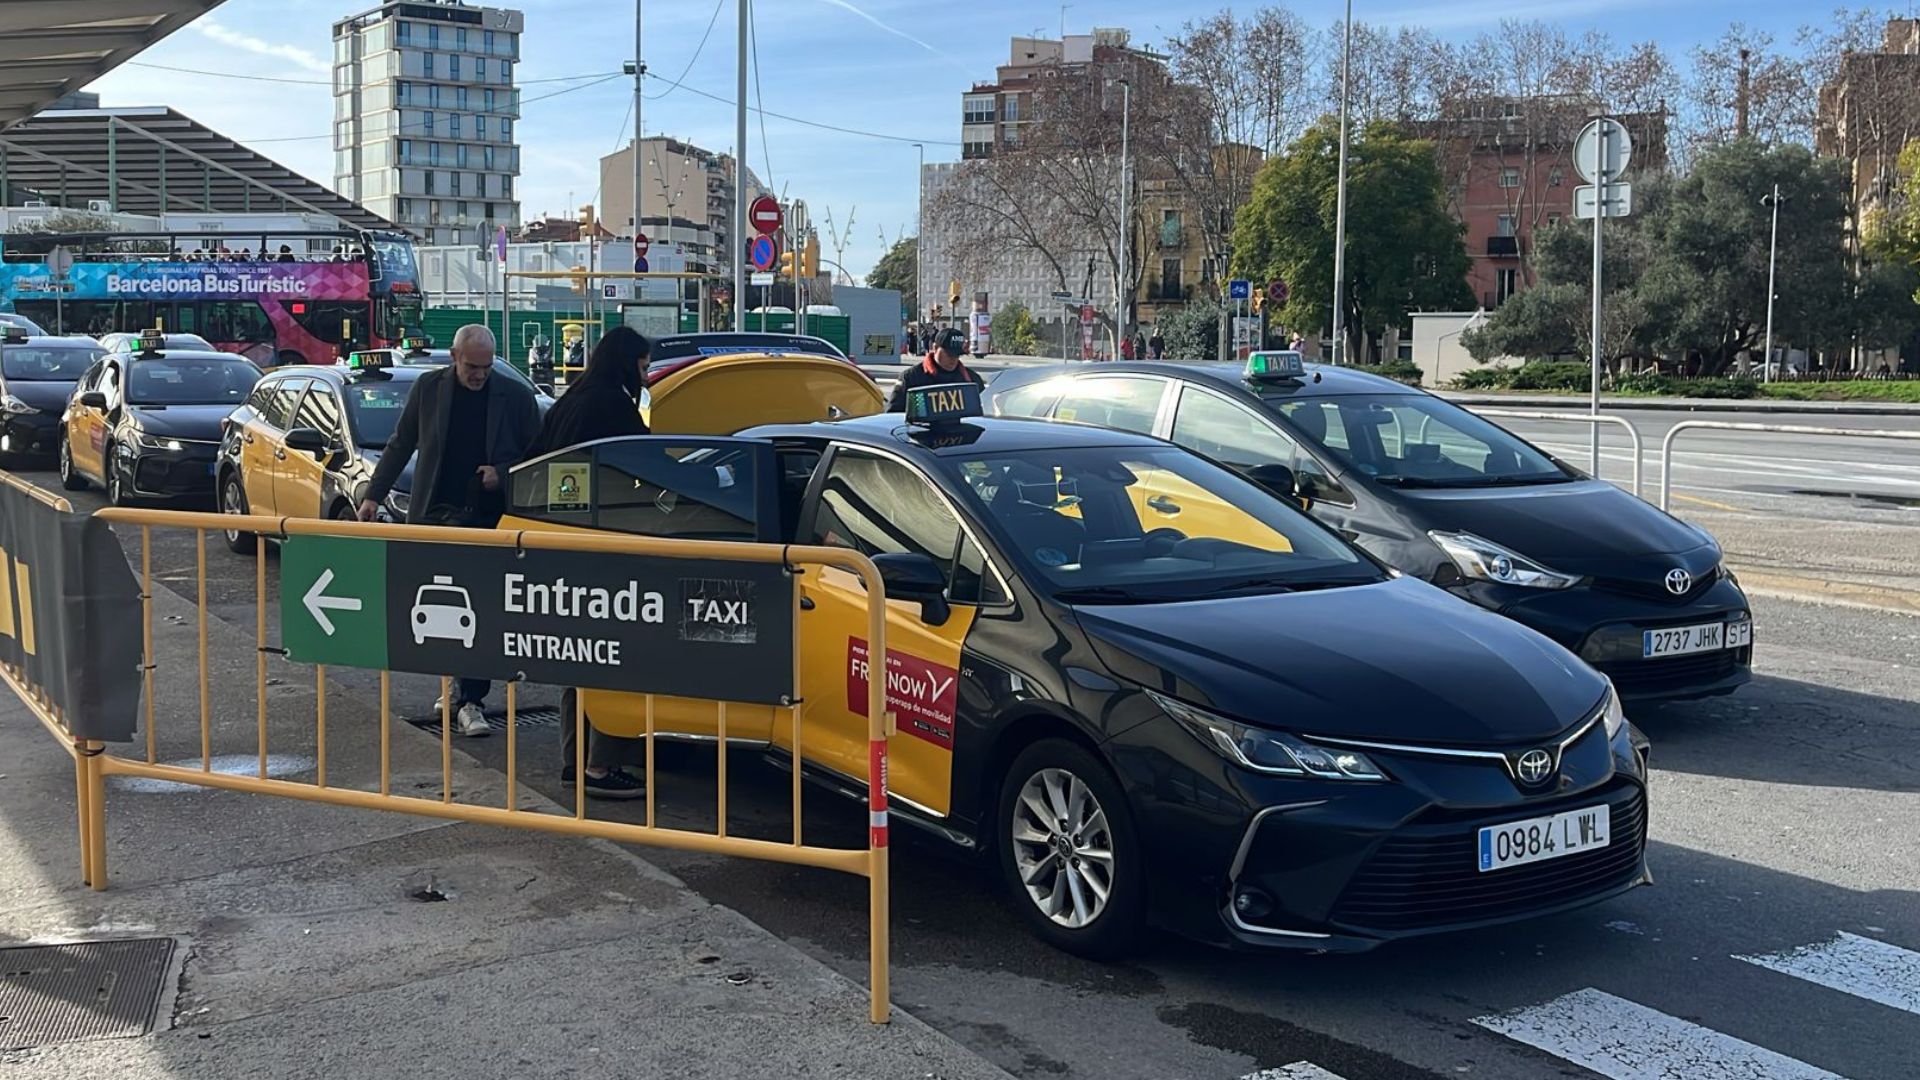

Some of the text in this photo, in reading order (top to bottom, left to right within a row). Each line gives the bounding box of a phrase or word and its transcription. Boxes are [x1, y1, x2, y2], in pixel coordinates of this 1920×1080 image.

[107, 274, 306, 293] Barcelona BusTurístic
[140, 340, 157, 348] TAXI
[410, 339, 424, 347] TAXI
[360, 354, 382, 366] TAXI
[1266, 356, 1289, 372] TAXI
[927, 389, 965, 413] TAXI
[504, 573, 748, 625] Entrada TAXI
[1654, 630, 1690, 653] 2737
[1695, 626, 1719, 648] JHK
[1729, 624, 1748, 645] SP
[504, 632, 621, 666] ENTRANCE
[913, 704, 921, 713] de
[922, 707, 952, 724] movilidad
[1497, 821, 1556, 862] 0984
[1564, 813, 1604, 849] LWL
